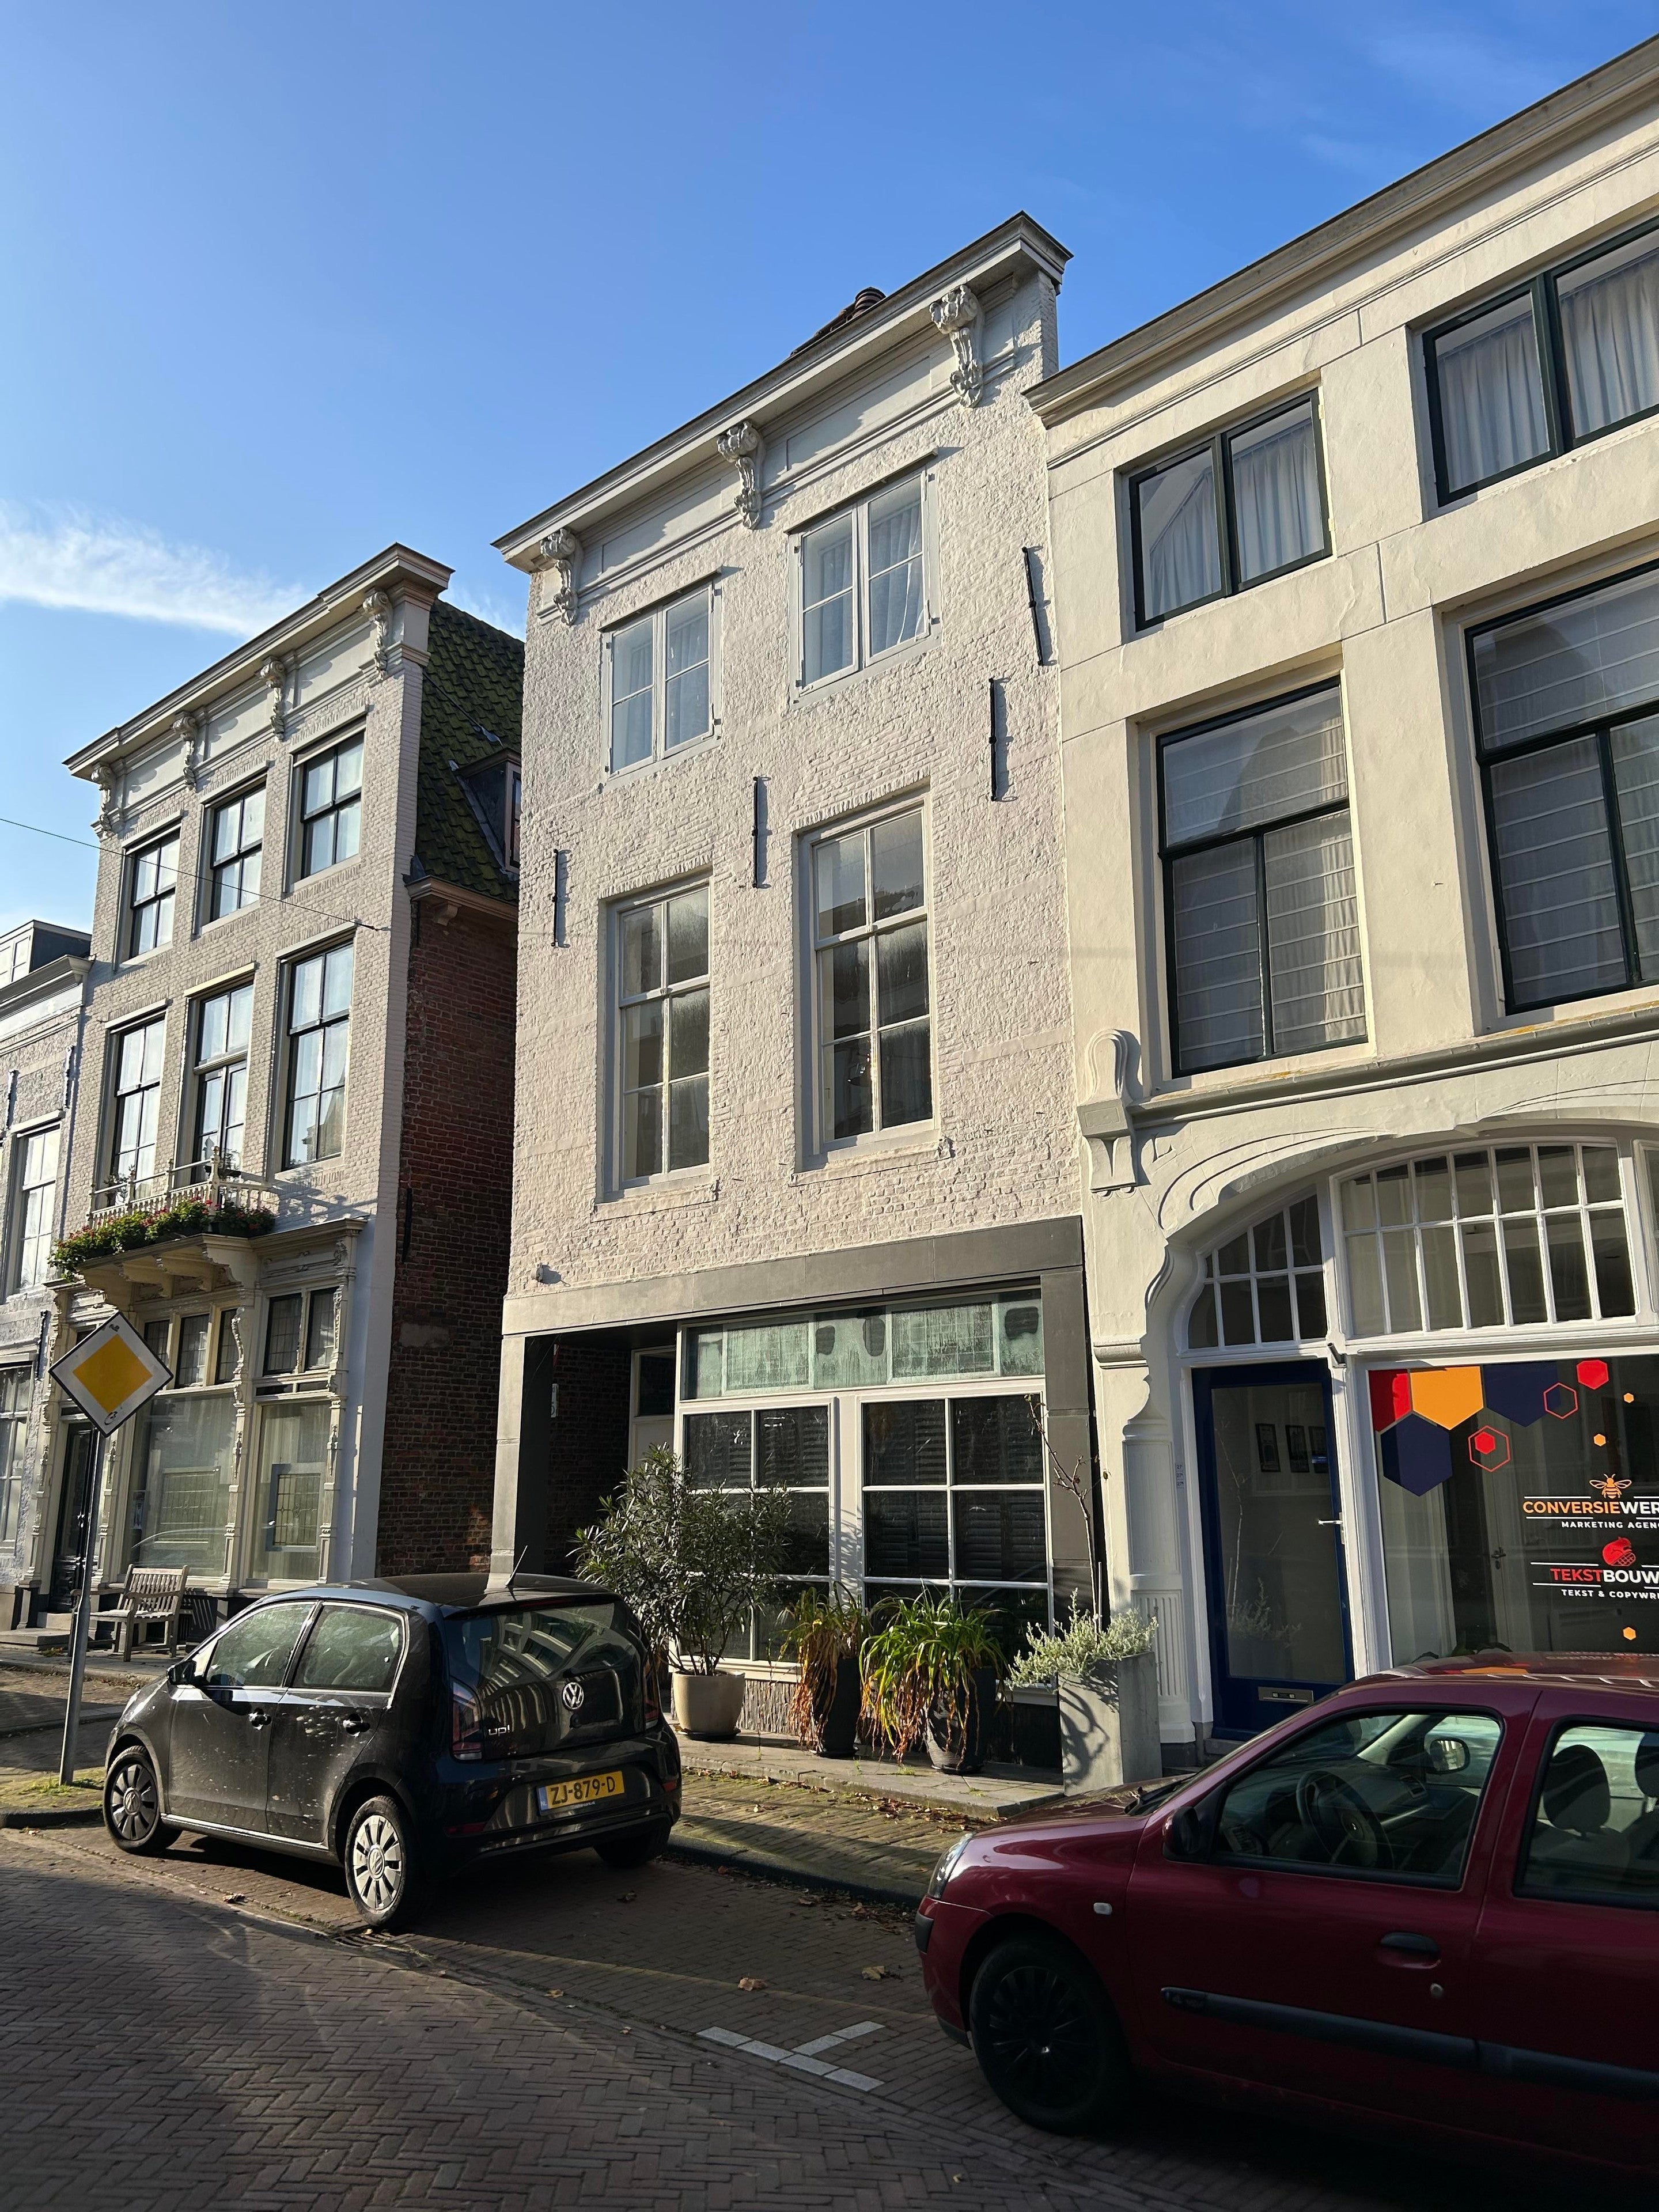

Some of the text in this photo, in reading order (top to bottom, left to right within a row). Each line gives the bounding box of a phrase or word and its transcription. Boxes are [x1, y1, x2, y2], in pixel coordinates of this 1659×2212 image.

[1522, 1501, 1659, 1514] CONVERSIEWER
[1550, 1568, 1659, 1584] TEKSTBOUW
[1561, 1589, 1594, 1597] TEKST
[488, 1724, 510, 1737] up!
[550, 1776, 615, 1805] ZJ-879-D
